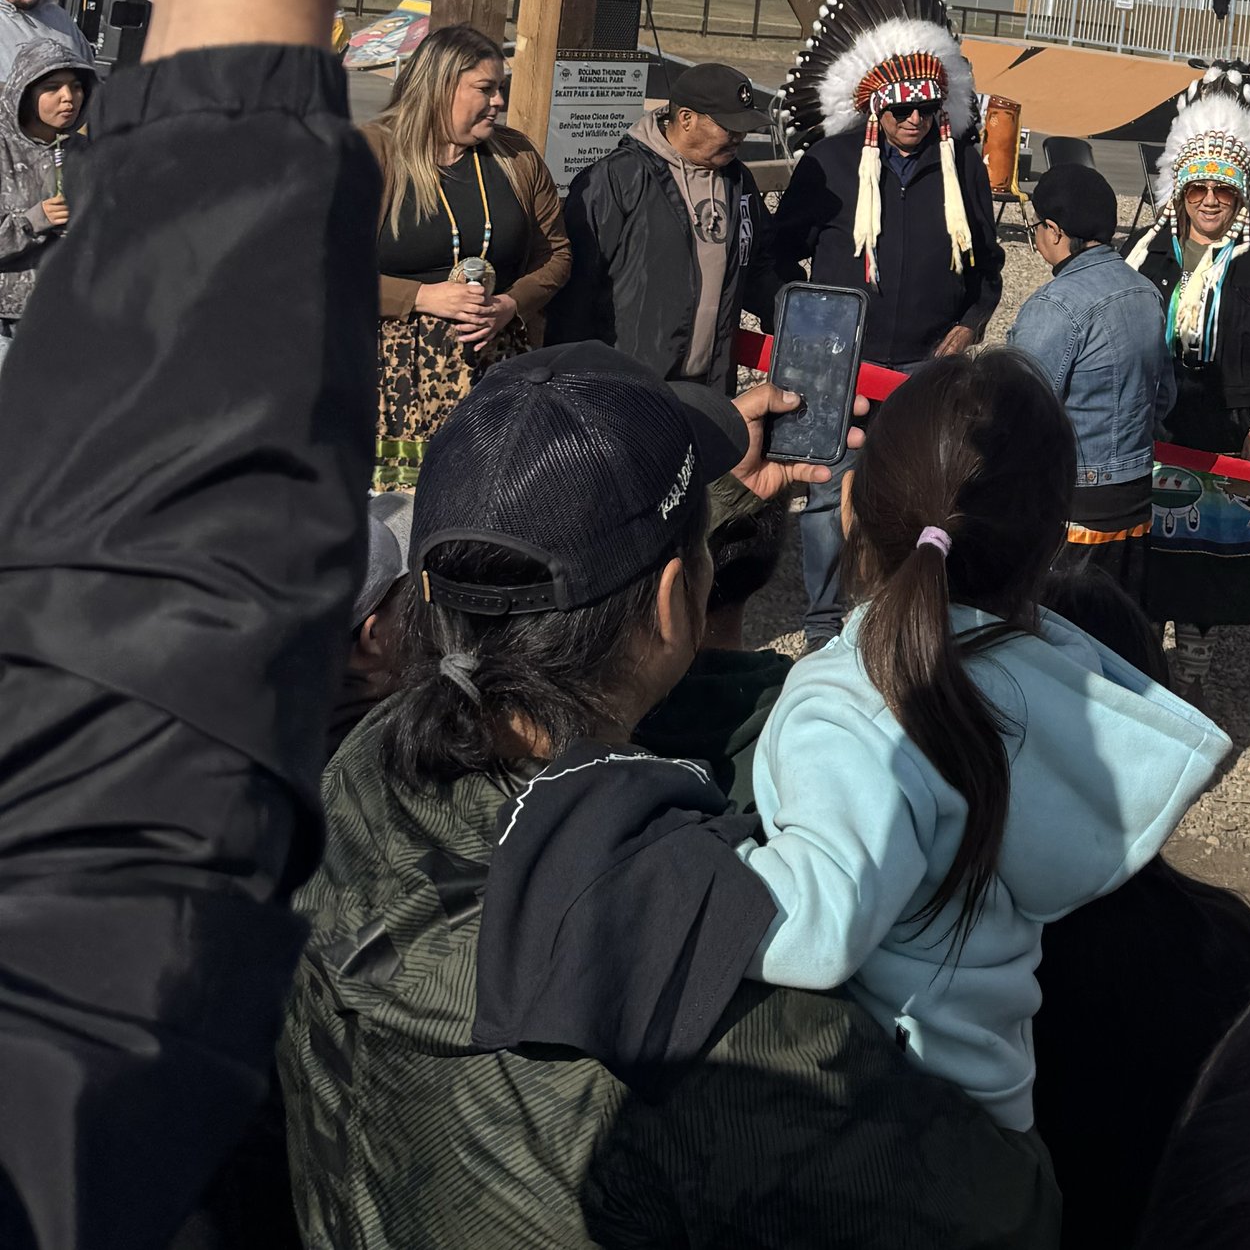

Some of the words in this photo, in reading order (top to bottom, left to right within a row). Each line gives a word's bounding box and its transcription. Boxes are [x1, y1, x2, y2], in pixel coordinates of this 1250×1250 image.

[578, 68, 601, 76] ROLLING
[602, 68, 627, 76] THUNDER
[559, 121, 581, 129] Behind
[602, 121, 617, 130] Keep
[571, 130, 584, 138] and
